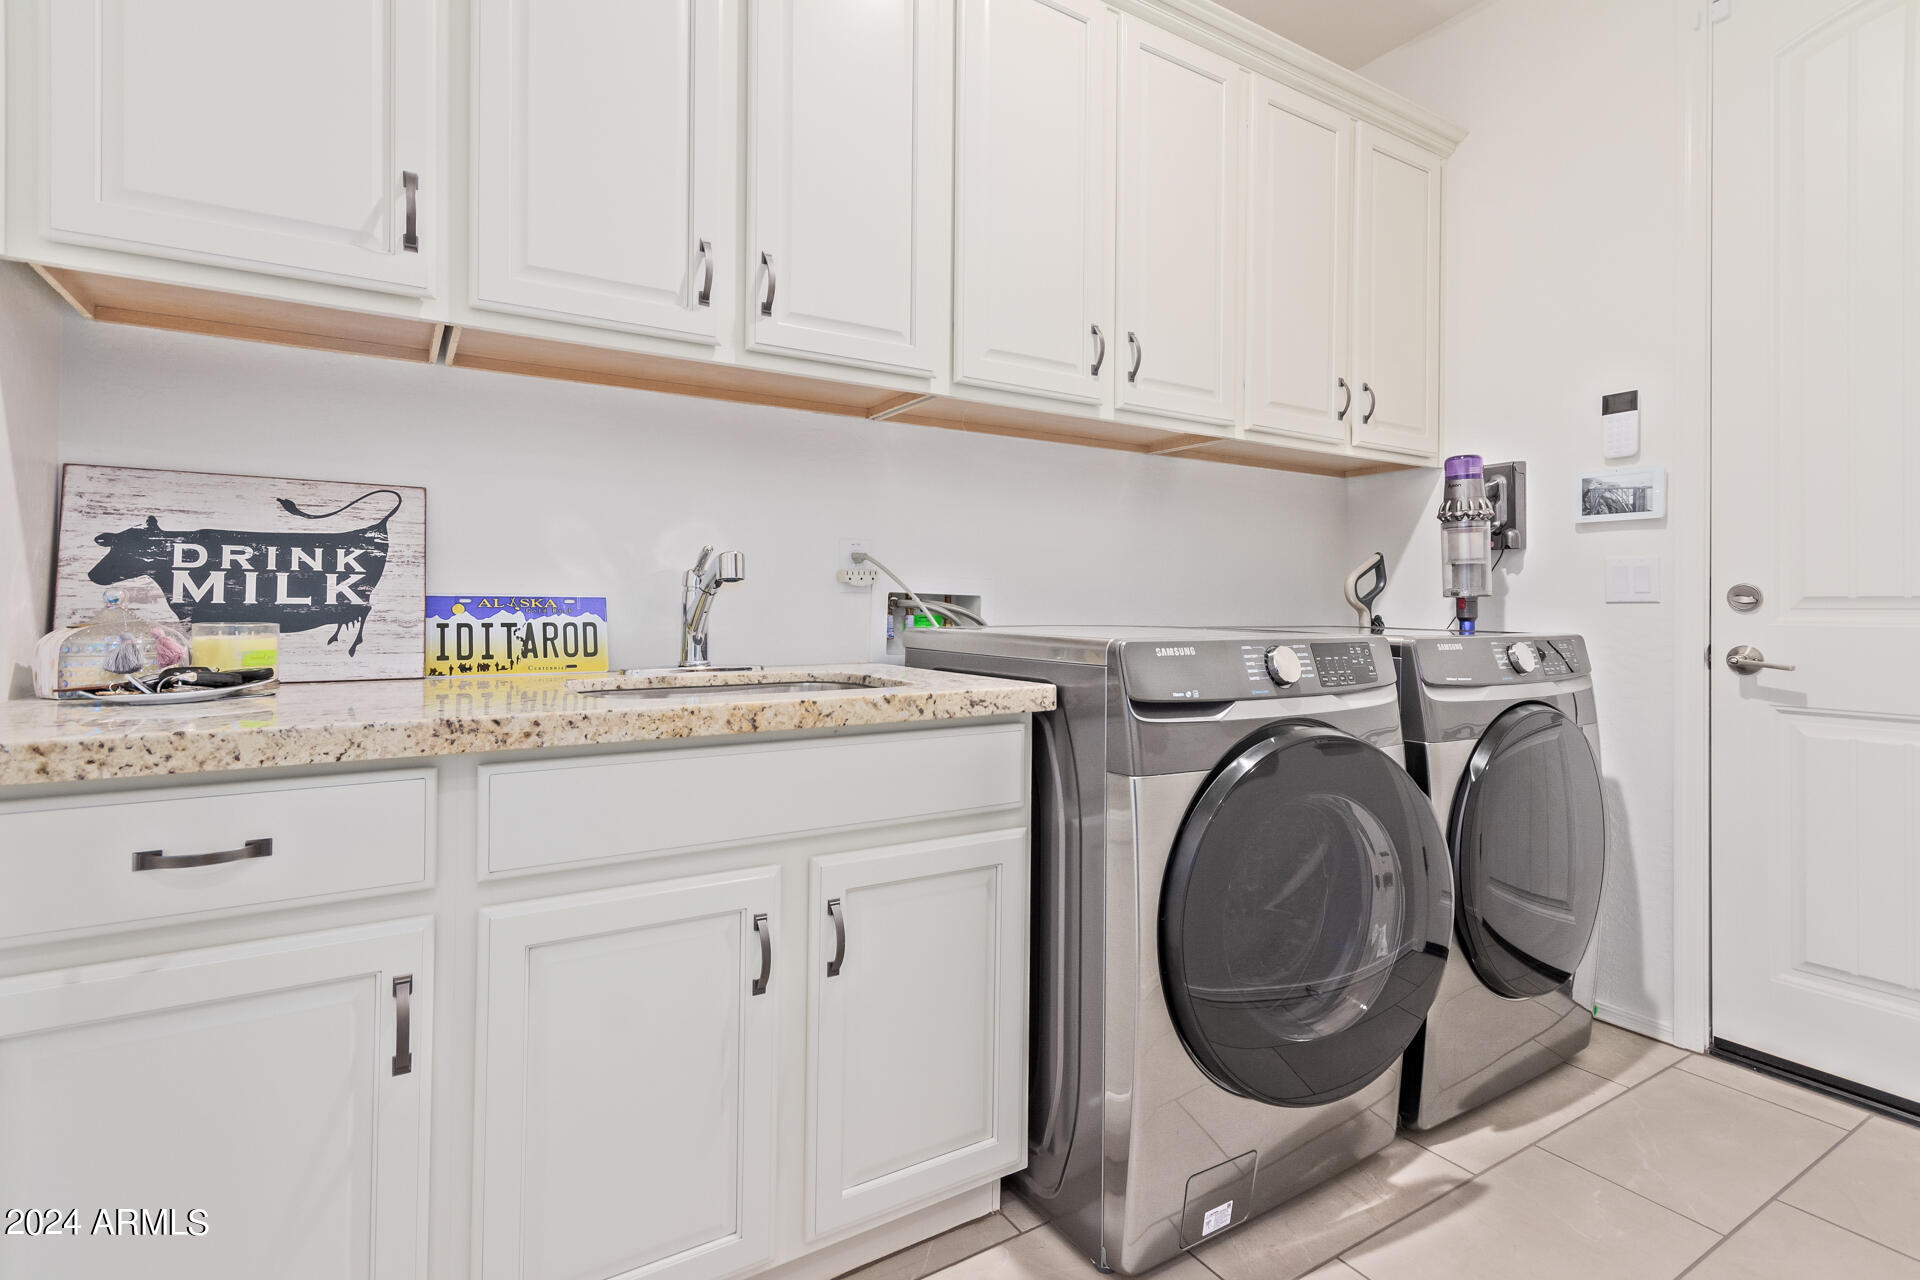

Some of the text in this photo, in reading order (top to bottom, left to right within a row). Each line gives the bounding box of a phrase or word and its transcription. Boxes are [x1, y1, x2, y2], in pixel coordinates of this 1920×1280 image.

[172, 543, 367, 573] DRINK
[171, 570, 367, 606] MILK
[478, 597, 558, 610] ALASKA
[436, 621, 599, 661] IDITAROD
[1155, 646, 1196, 657] SAMSUNG
